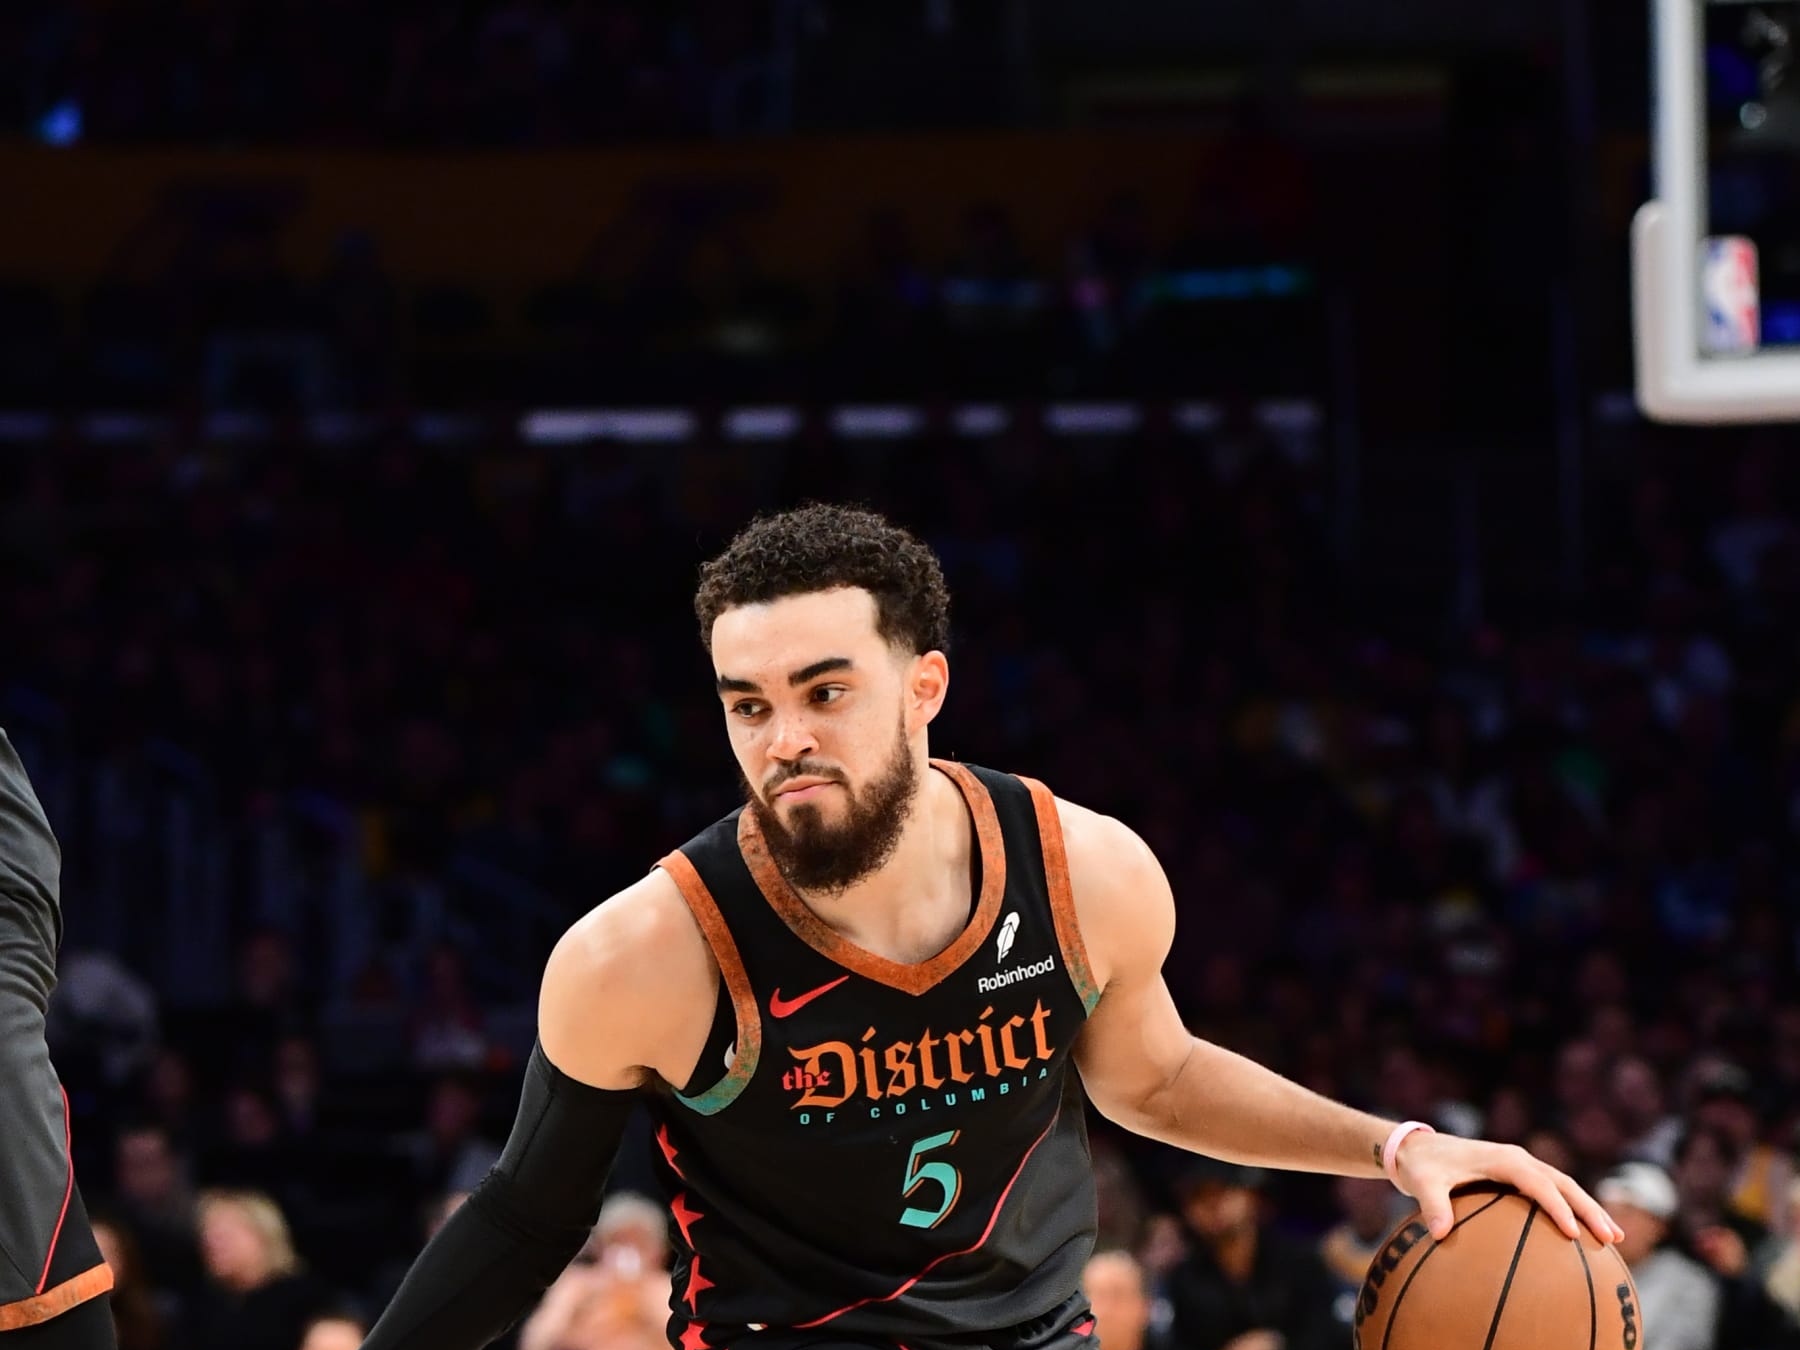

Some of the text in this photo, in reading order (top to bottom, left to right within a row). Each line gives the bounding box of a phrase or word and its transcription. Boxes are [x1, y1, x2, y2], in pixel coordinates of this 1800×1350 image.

[978, 955, 1055, 994] Robinhood
[782, 998, 1055, 1110] the District
[799, 1067, 1048, 1126] OF COLUMBIA
[899, 1129, 962, 1230] 5
